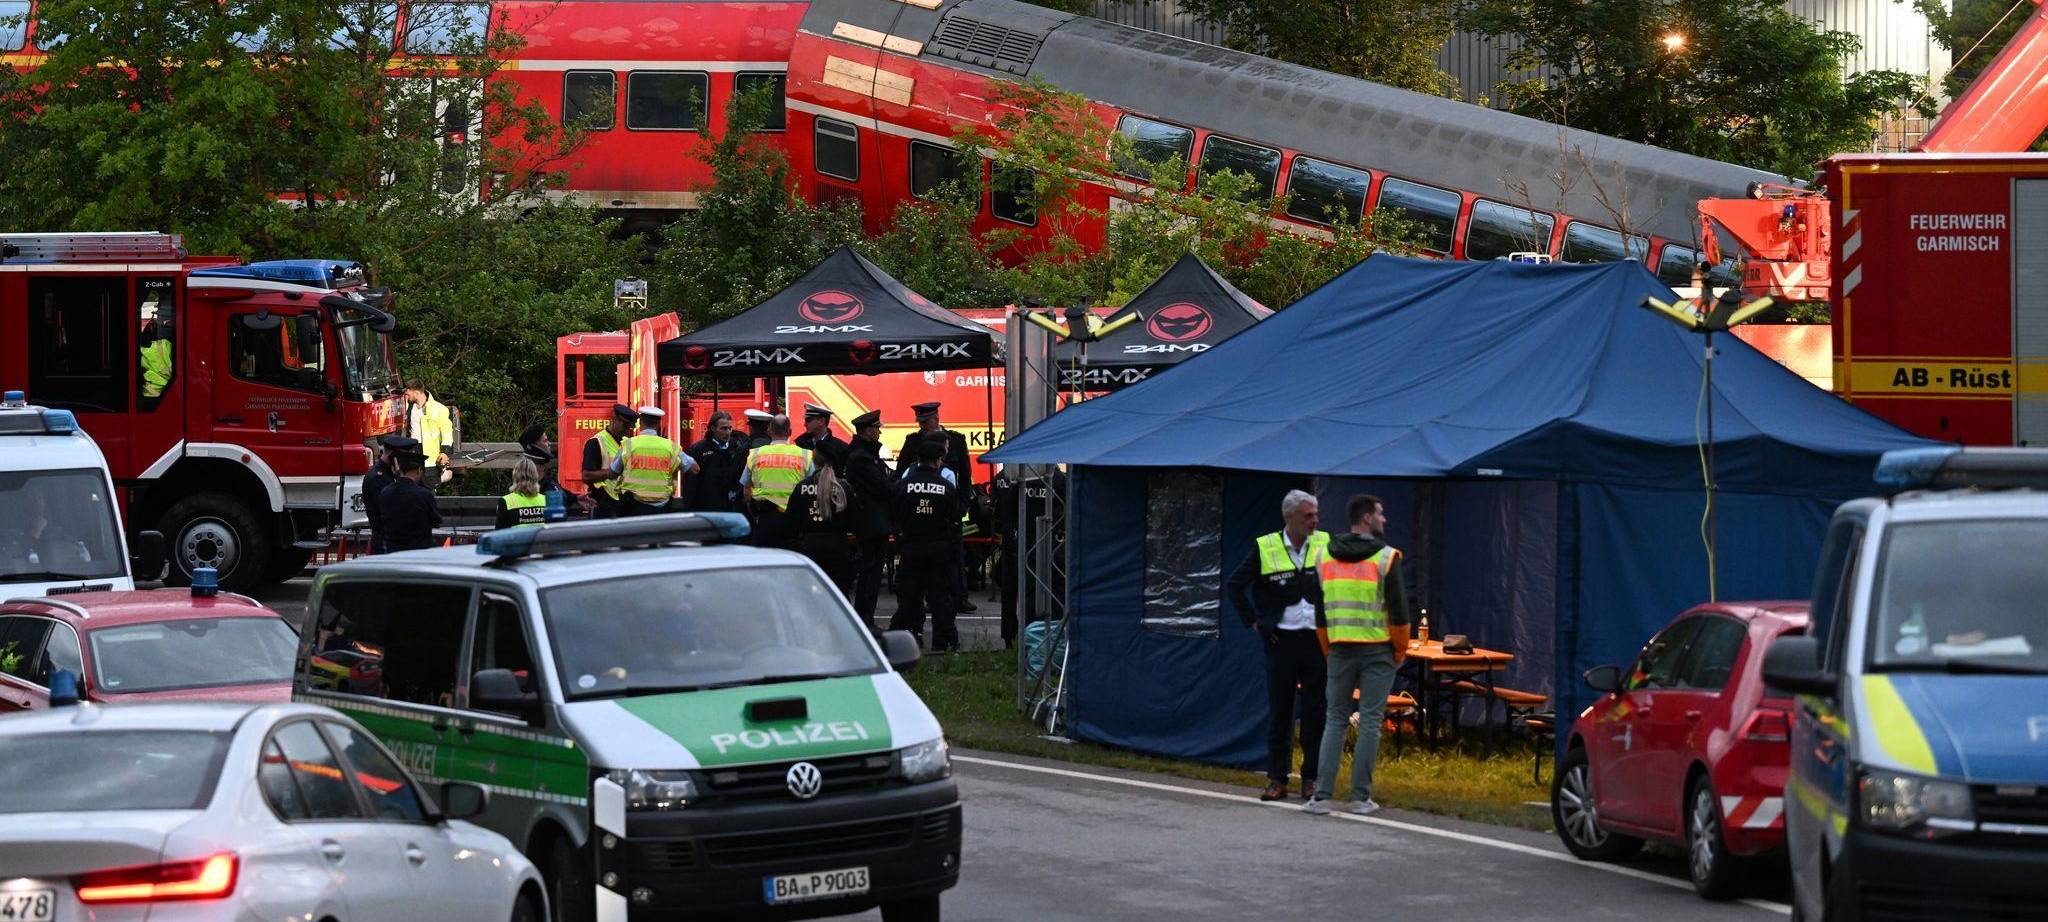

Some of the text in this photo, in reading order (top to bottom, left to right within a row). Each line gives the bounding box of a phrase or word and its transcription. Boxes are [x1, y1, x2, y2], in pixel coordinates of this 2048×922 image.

[1909, 214, 2006, 230] FEUERWEHR
[1916, 236, 1999, 251] GARMISCH
[774, 324, 873, 335] 24MX
[713, 346, 806, 368] 24MX
[880, 341, 973, 361] 24MX
[1892, 367, 1929, 387] AB
[1949, 366, 2012, 389] Rüst
[907, 482, 946, 495] POLIZEI
[915, 506, 933, 515] 5411
[919, 499, 930, 507] BY
[711, 720, 870, 755] POLIZEI
[775, 877, 800, 898] BA
[824, 870, 867, 892] 9003
